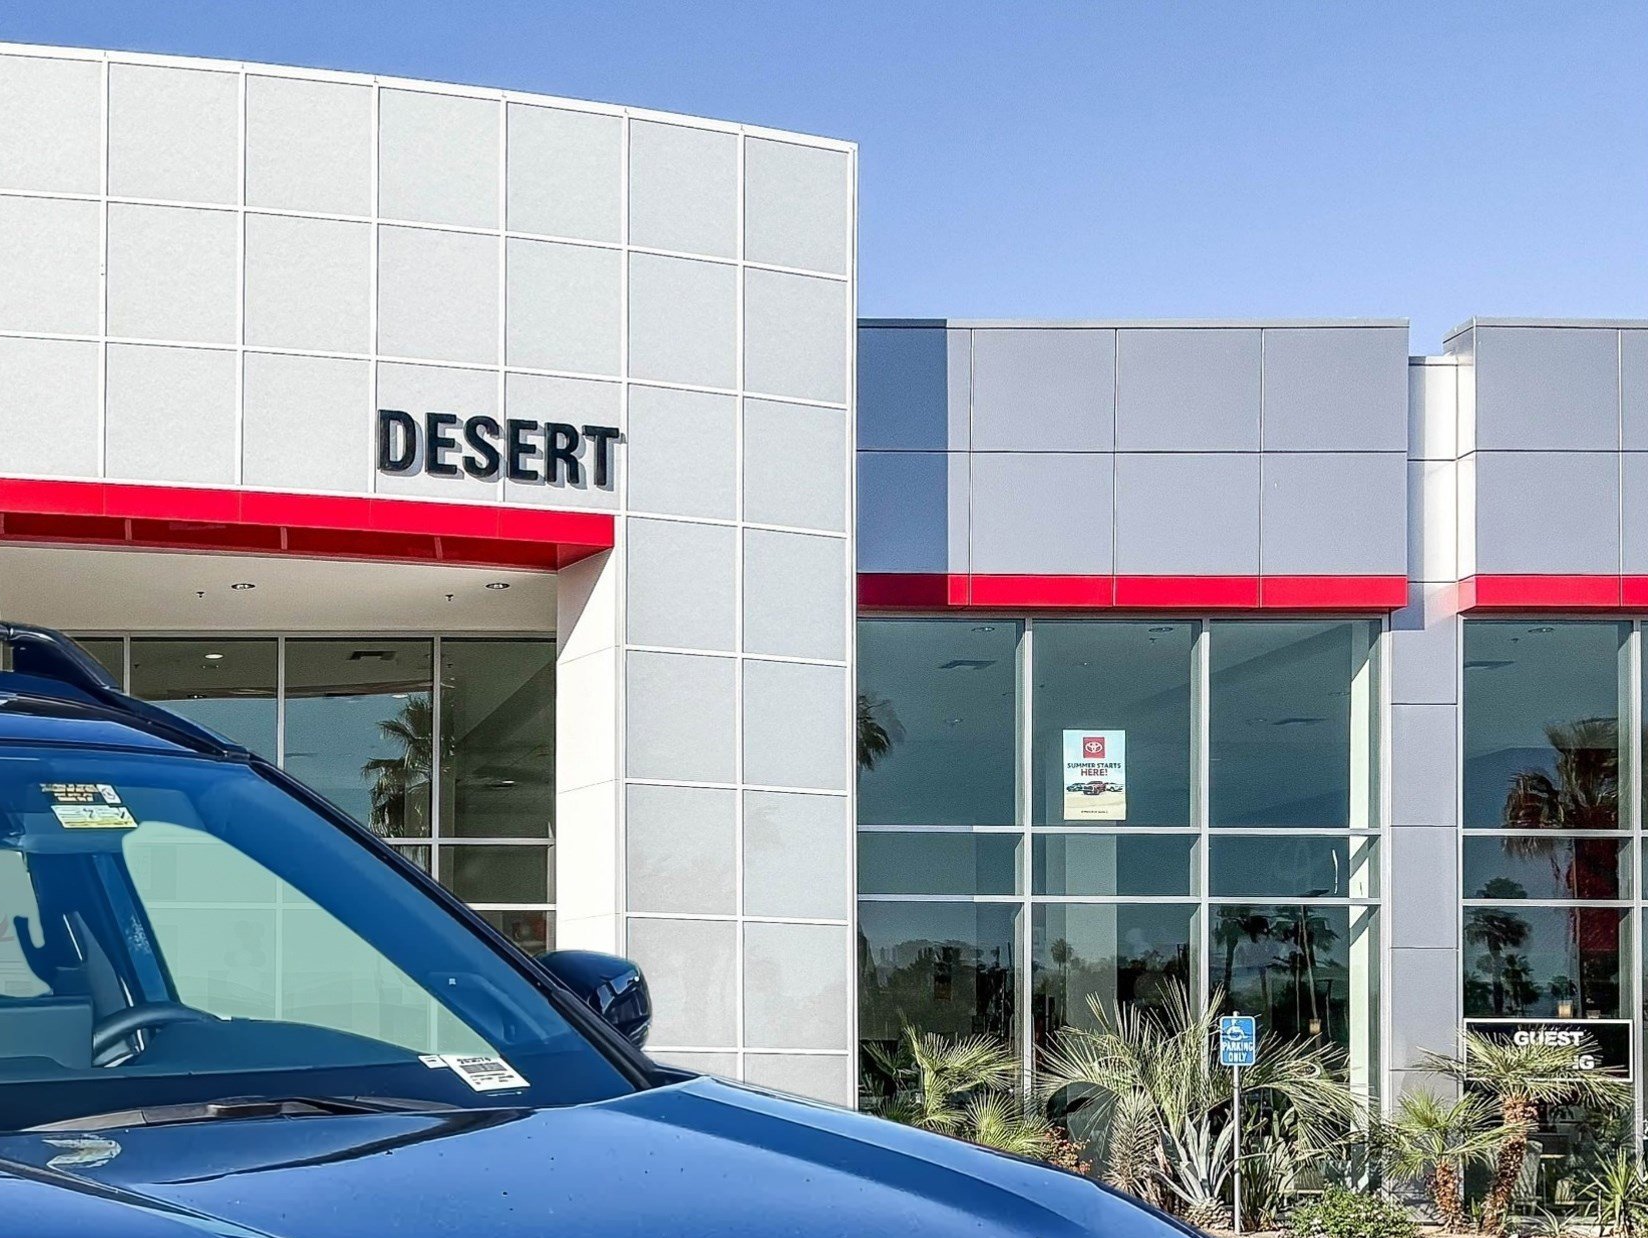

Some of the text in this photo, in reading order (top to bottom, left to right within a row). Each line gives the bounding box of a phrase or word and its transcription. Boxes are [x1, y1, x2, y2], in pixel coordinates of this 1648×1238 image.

[377, 409, 620, 487] DESERT
[1080, 768, 1108, 776] HERE!
[1513, 1030, 1584, 1047] GUEST
[1222, 1041, 1254, 1052] PARKING
[1228, 1052, 1248, 1062] ONLY
